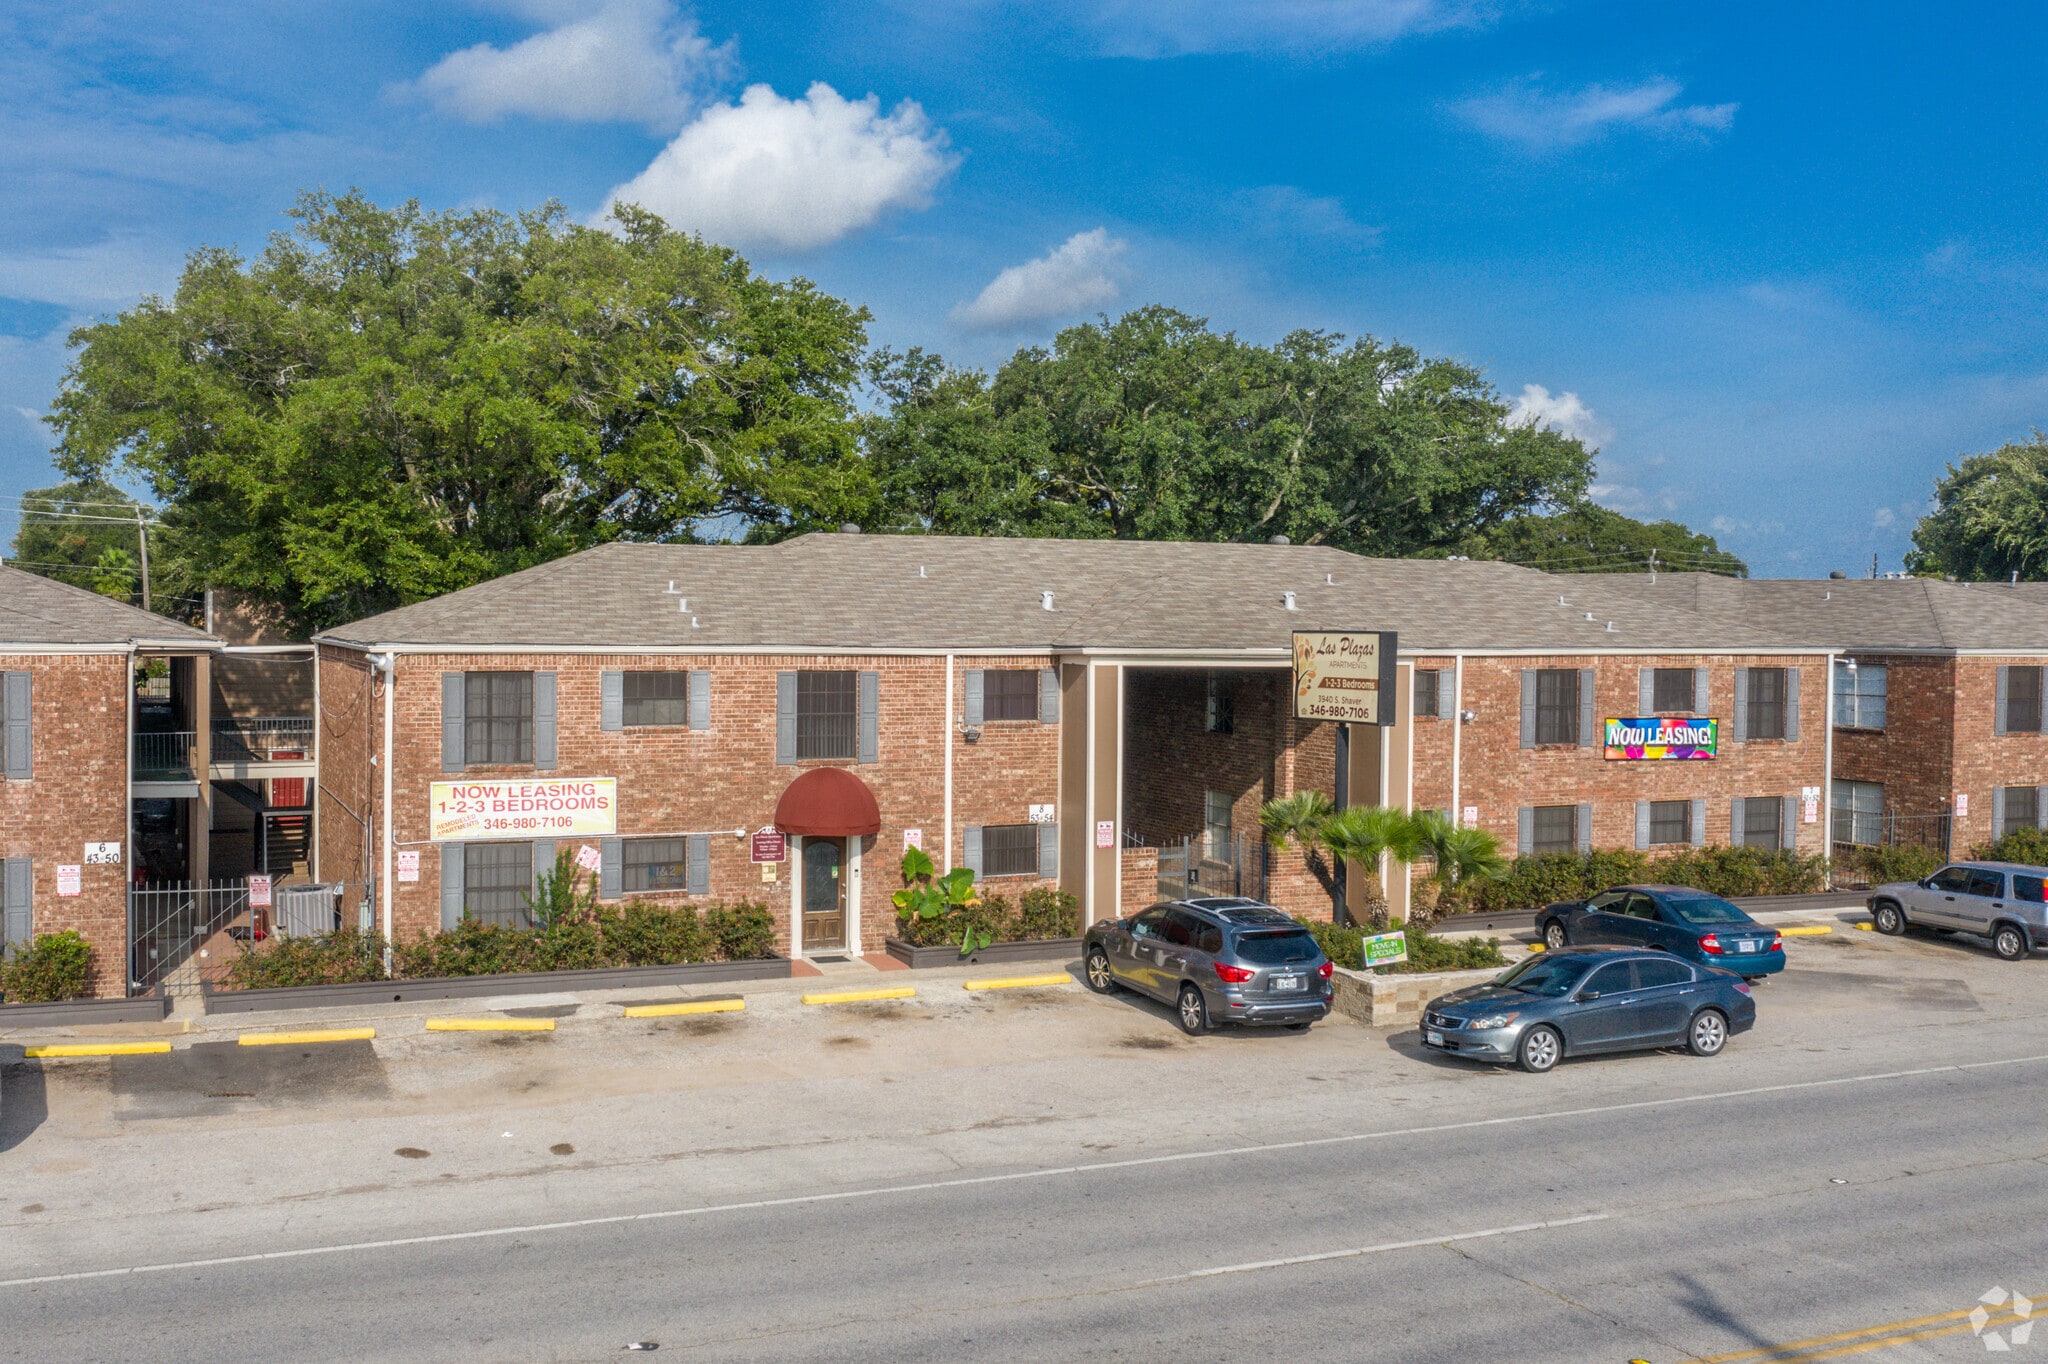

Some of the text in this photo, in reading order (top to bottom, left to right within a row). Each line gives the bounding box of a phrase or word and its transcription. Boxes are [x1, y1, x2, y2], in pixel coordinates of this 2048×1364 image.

[1316, 636, 1374, 661] Las Plazas
[1329, 661, 1368, 669] APARTMENTS
[1325, 678, 1375, 689] 1-2-3 Bedrooms
[1318, 695, 1334, 703] 3940
[1341, 696, 1362, 705] Shaver
[1309, 704, 1369, 719] 346-980-7106
[1608, 727, 1712, 745] NOW LEASING!
[452, 783, 596, 799] NOW LEASING
[438, 796, 609, 814] 1-2-3 BEDROOMS
[436, 813, 476, 830] REMODELED
[437, 820, 479, 836] APARTMENTS
[484, 816, 573, 830] 346-980-7106
[99, 842, 106, 853] 6
